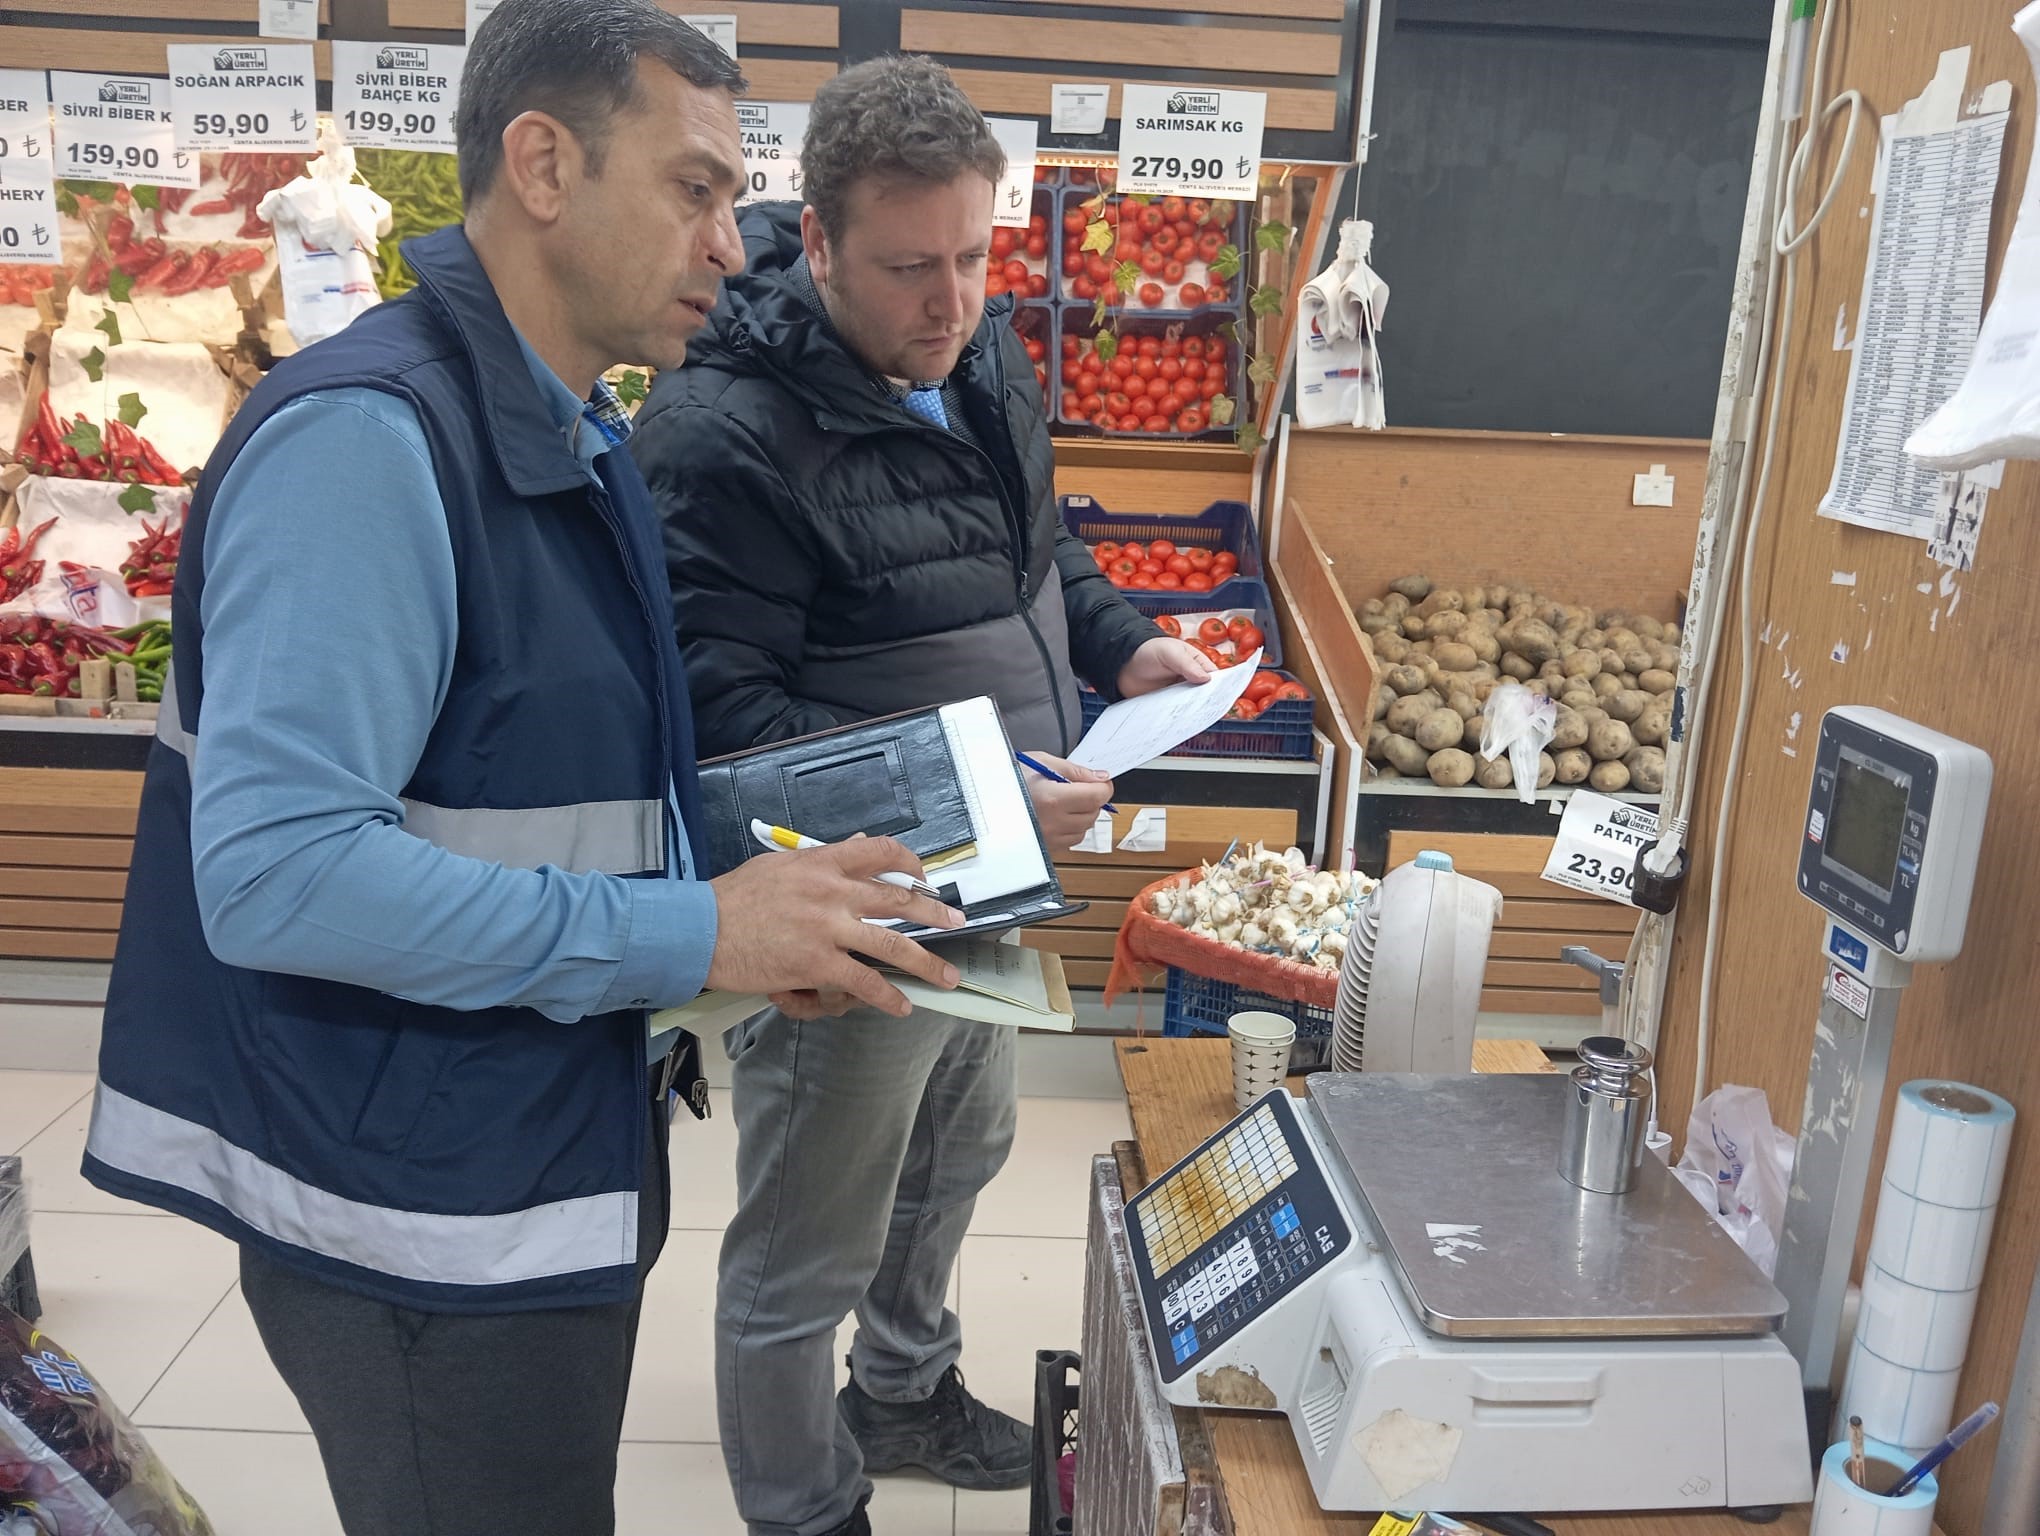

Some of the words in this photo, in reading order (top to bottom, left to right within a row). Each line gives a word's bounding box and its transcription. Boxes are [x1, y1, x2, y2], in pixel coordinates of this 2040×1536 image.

[234, 52, 256, 60] YERLİ
[234, 60, 264, 68] ÜRETİM
[395, 60, 425, 68] ÜRETİM
[175, 74, 230, 88] SOĞAN
[235, 75, 304, 87] ARPACIK
[356, 72, 394, 86] SİVRİ
[400, 72, 448, 88] BİBER
[118, 85, 141, 94] YERLİ
[118, 92, 147, 102] ÜRETİM
[361, 89, 412, 104] BAHÇE
[418, 91, 440, 103] KG
[1188, 96, 1210, 104] YERLİ
[63, 102, 103, 118] SİVRİ
[108, 105, 155, 122] BİBER
[1187, 104, 1216, 112] ÜRETİM
[194, 114, 269, 137] 59,90
[345, 110, 436, 136] 199,90
[1136, 118, 1216, 132] SARIMSAK
[1221, 121, 1243, 133] KG
[67, 142, 158, 169] 159,90
[758, 148, 780, 159] KG
[1132, 156, 1223, 182] 279,90
[0, 226, 19, 247] 0
[1820, 776, 1829, 792] kg
[1634, 814, 1656, 826] YERLİ
[1910, 820, 1920, 838] kg
[1900, 872, 1910, 888] TL
[1314, 1225, 1336, 1254] CAS
[1233, 1244, 1244, 1253] 7
[1237, 1256, 1248, 1266] 8
[1212, 1263, 1222, 1272] 4
[1242, 1268, 1252, 1278] 9
[1216, 1274, 1226, 1283] 5
[1191, 1280, 1200, 1288] 1
[1193, 1291, 1204, 1300] 2
[1219, 1286, 1230, 1296] 6
[1168, 1293, 1179, 1307] 00
[1172, 1308, 1183, 1317] 0
[1197, 1303, 1208, 1313] 3
[1175, 1320, 1185, 1330] C
